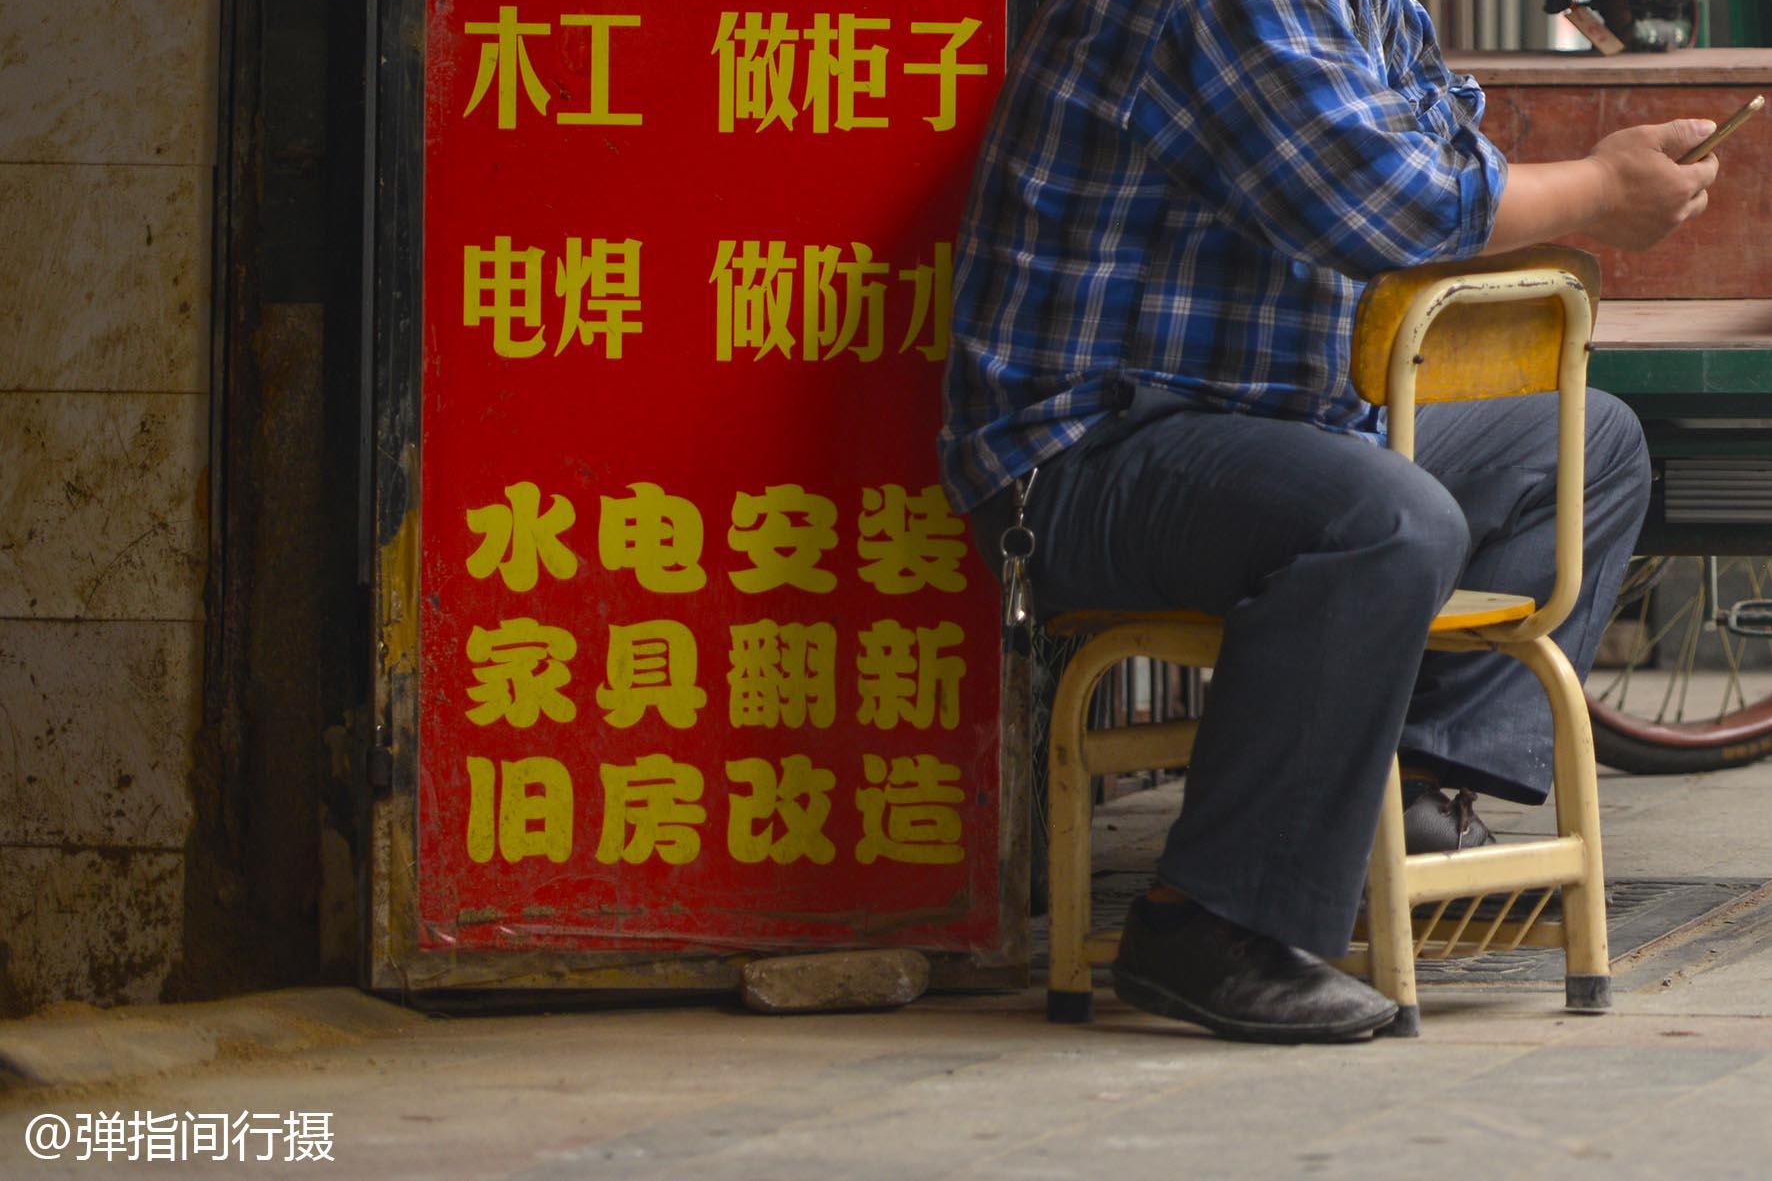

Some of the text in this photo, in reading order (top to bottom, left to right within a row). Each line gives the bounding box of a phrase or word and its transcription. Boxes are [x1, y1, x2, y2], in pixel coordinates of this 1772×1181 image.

[463, 6, 988, 135] 木工 做柜子
[462, 235, 643, 360] 电焊
[466, 481, 968, 595] 水电安装
[466, 618, 967, 730] 家具翻新
[466, 753, 966, 866] 旧房改造
